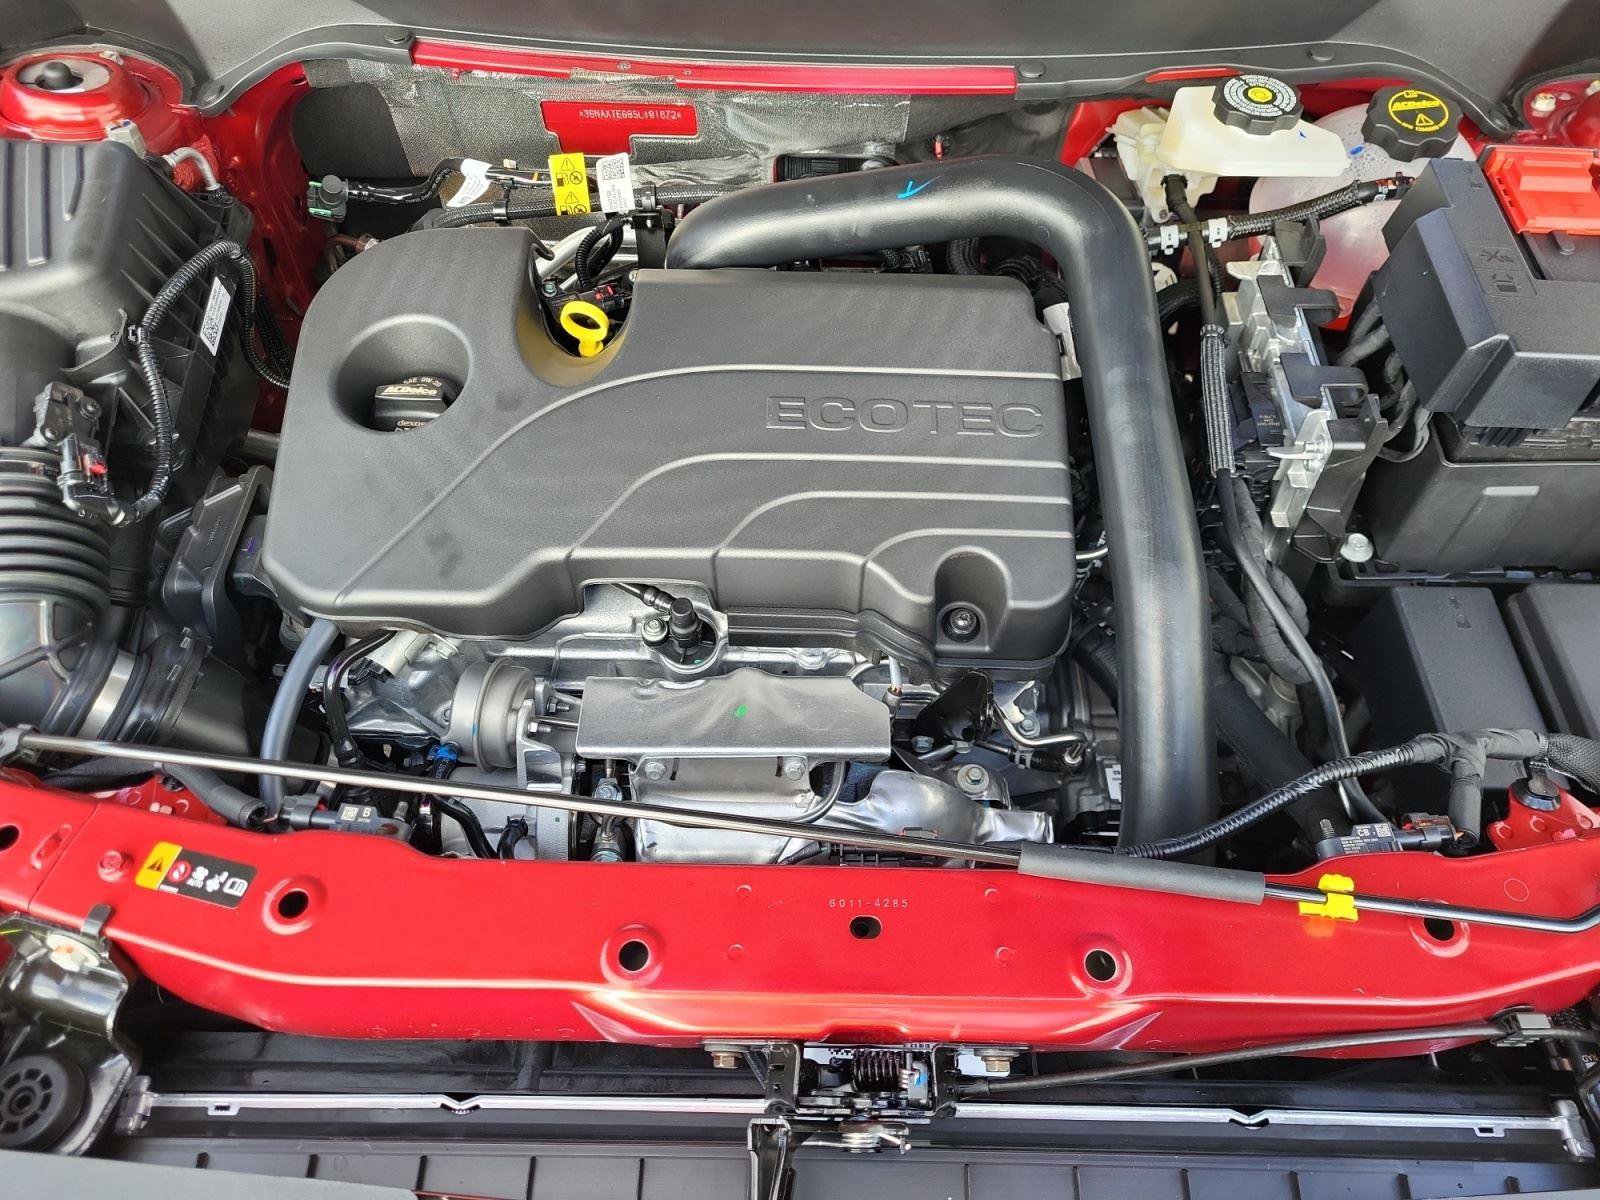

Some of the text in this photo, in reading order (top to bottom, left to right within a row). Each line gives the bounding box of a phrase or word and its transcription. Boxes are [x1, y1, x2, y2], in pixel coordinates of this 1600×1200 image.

[403, 377, 418, 385] SAE
[381, 386, 438, 396] ACDelco
[766, 396, 1044, 438] ECOTEC
[1357, 828, 1370, 837] CB
[828, 898, 908, 909] 6011-4285
